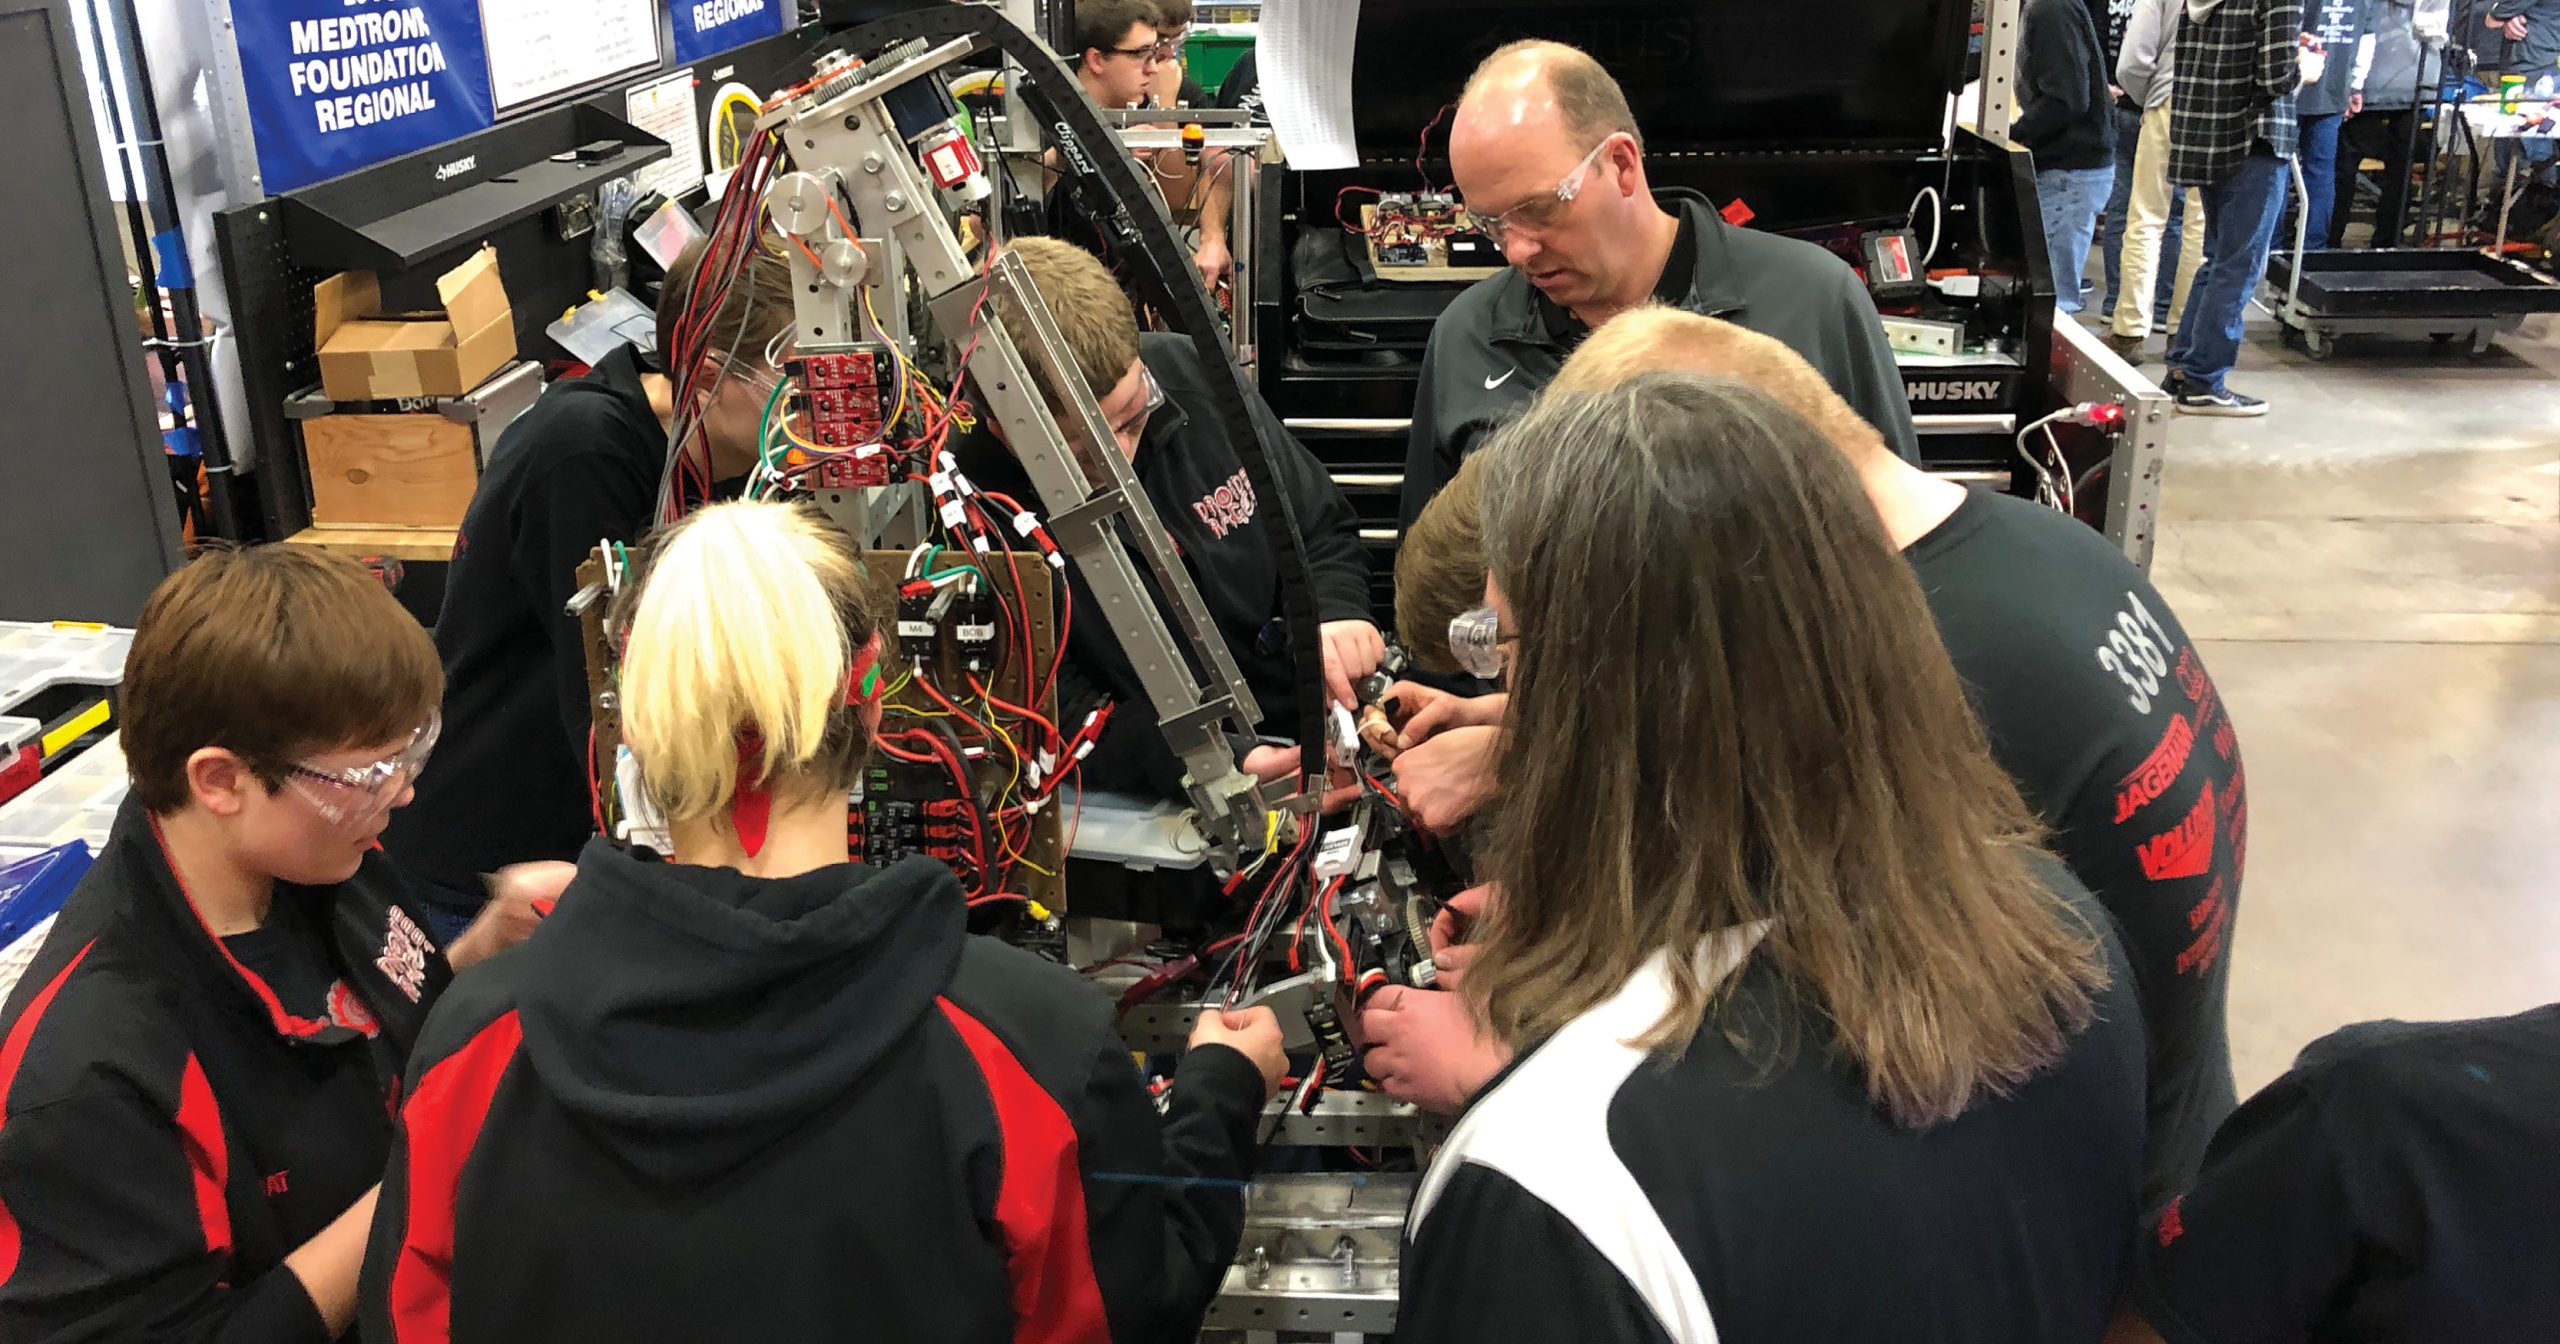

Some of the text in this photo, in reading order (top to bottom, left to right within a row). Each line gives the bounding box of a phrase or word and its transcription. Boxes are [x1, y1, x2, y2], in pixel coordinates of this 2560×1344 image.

[289, 42, 446, 96] FOUNDATION
[315, 80, 436, 133] REGIONAL
[1055, 121, 1095, 174] Clippard
[1907, 381, 2000, 400] HUSKY
[2098, 590, 2174, 715] 3381
[2136, 777, 2215, 878] VOLLR
